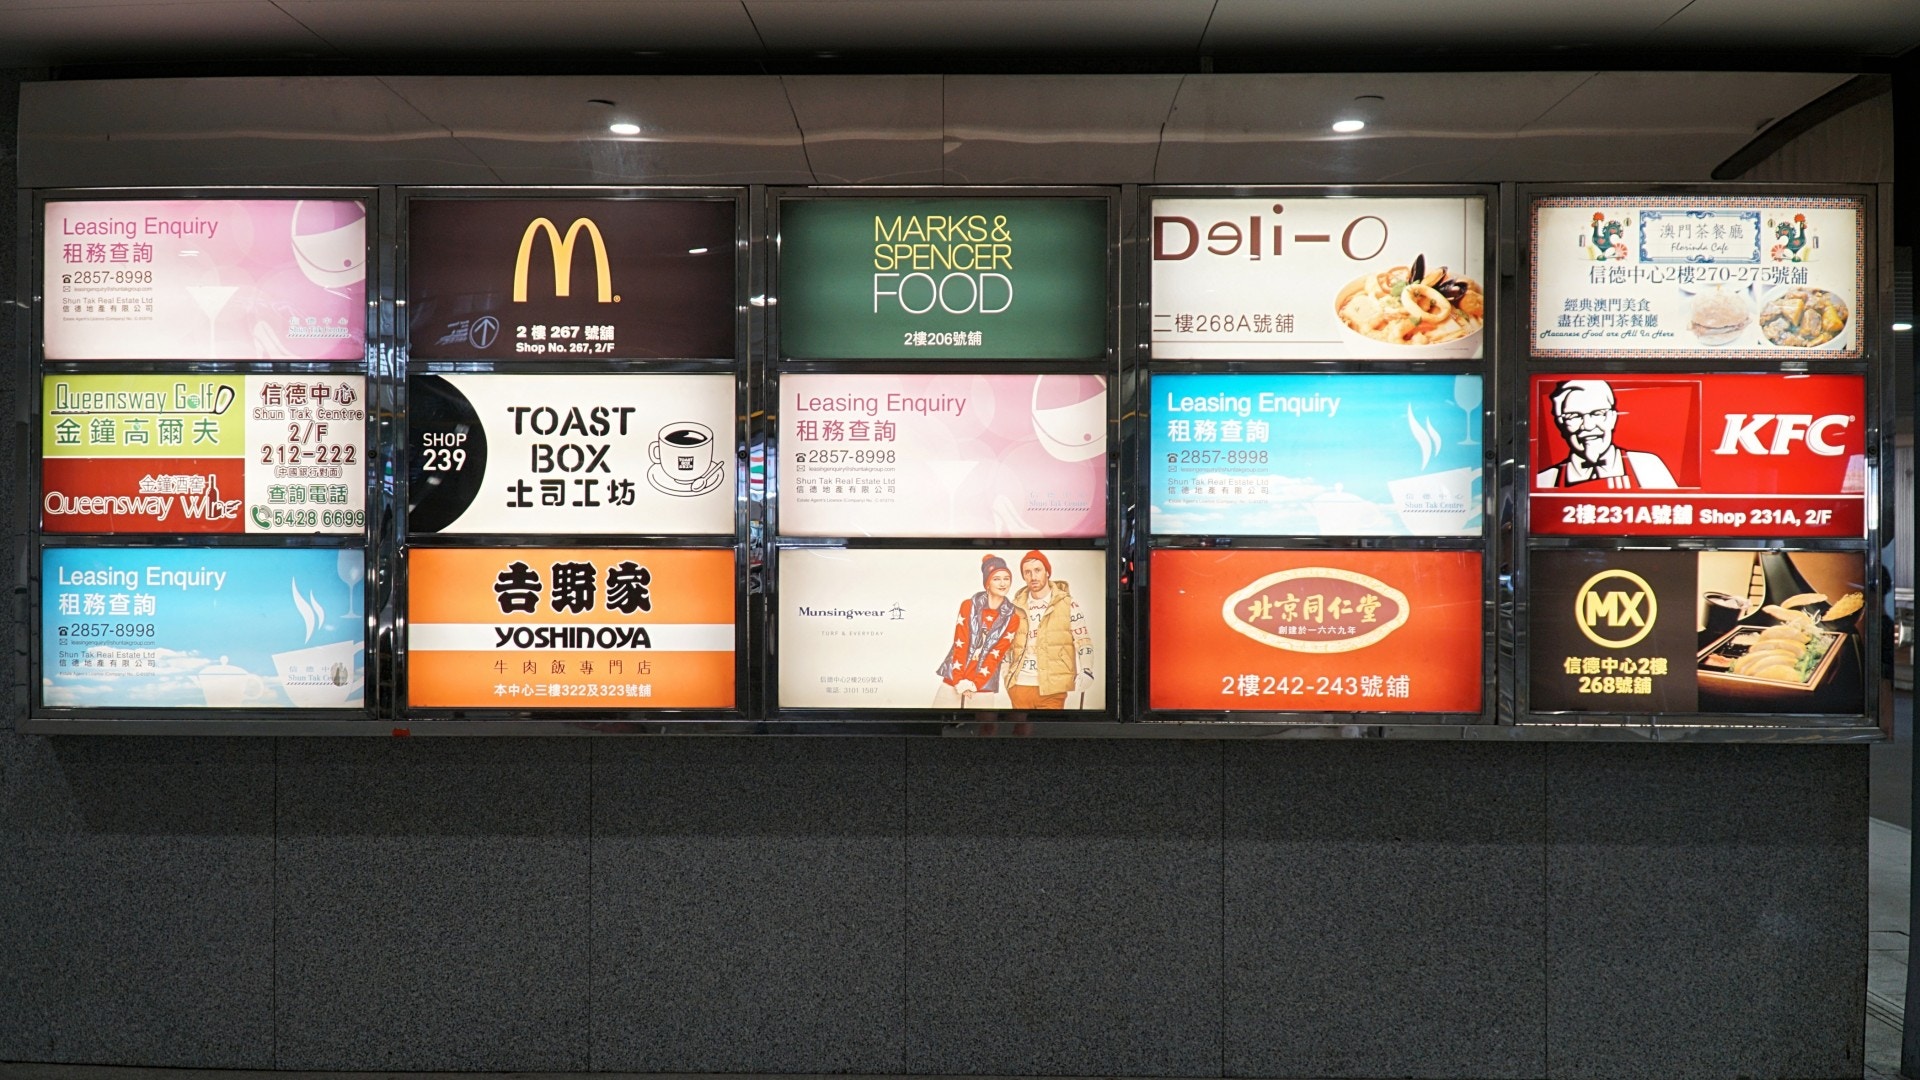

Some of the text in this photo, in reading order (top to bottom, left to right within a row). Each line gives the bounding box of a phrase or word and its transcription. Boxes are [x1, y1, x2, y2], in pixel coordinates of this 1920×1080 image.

[63, 217, 219, 239] Leasing Enquiry
[875, 215, 1012, 242] MARKS &
[1660, 223, 1744, 239] 澳門茶餐廳
[63, 242, 153, 264] 租務查詢
[874, 243, 1013, 270] SPENCER
[1671, 242, 1729, 253] Florinda Cafe
[74, 270, 153, 284] 2857-8998
[1590, 265, 1808, 284] 信德中心2樓270-275號舖
[873, 272, 1014, 314] FOOD
[1564, 298, 1651, 312] 經典澳門美食
[1153, 314, 1294, 333] 二樓268A號舖
[1557, 314, 1659, 328] 盡在澳門茶餐廳
[516, 325, 614, 341] 2 樓 267 號舖
[903, 331, 982, 346] 2樓206號舖
[1540, 330, 1580, 339] Macanese
[1581, 330, 1605, 339] Food
[1620, 330, 1637, 339] All
[1651, 330, 1674, 339] Here
[515, 343, 615, 355] Shop No. 267, 2/F
[56, 383, 167, 414] Queensway
[261, 383, 357, 405] 信德中心
[254, 407, 364, 420] Shun Tak Centre
[796, 393, 967, 416] Leasing Enquiry
[1167, 392, 1341, 417] Leasing Enquiry
[507, 406, 636, 436] TOAST
[796, 419, 896, 442] 租務查詢
[55, 418, 220, 445] 金鐘高爾夫
[289, 421, 328, 444] 2/F
[422, 433, 467, 447] SHOP
[1168, 420, 1270, 443] 租務查詢
[1714, 414, 1850, 456] KFC
[261, 445, 356, 464] 212-222
[422, 450, 467, 471] 239
[531, 444, 611, 473] BOX
[809, 449, 895, 463] 2857-8998
[1181, 450, 1269, 464] 2857-8998
[139, 474, 206, 494] 金鐘酒窖
[796, 477, 816, 485] Shun
[1168, 478, 1189, 486] Shun
[269, 485, 348, 503] 查詢電話
[507, 479, 635, 508] 土司工坊
[45, 492, 242, 521] Queensway Wine
[1562, 504, 1832, 527] 2樓231A號舖 Shop 231A, 2/F
[273, 510, 365, 527] 5428 6699
[59, 566, 227, 591] Leasing Enquiry
[59, 593, 156, 616] 租務查詢
[799, 606, 885, 619] Munsingwear
[1248, 593, 1382, 623] 北京同仁堂
[1587, 591, 1646, 627] MX
[71, 623, 155, 637] 2857-8998
[495, 627, 652, 649] YOSHINOYA
[1278, 626, 1356, 635] 創建於一六六九年
[494, 660, 651, 675] 牛肉飯專門店
[1564, 657, 1667, 675] 信德中心2樓
[494, 684, 652, 697] 本中心三樓322及323號舖
[1221, 674, 1410, 698] 2樓242-243號舖
[1579, 677, 1652, 694] 268號舖
